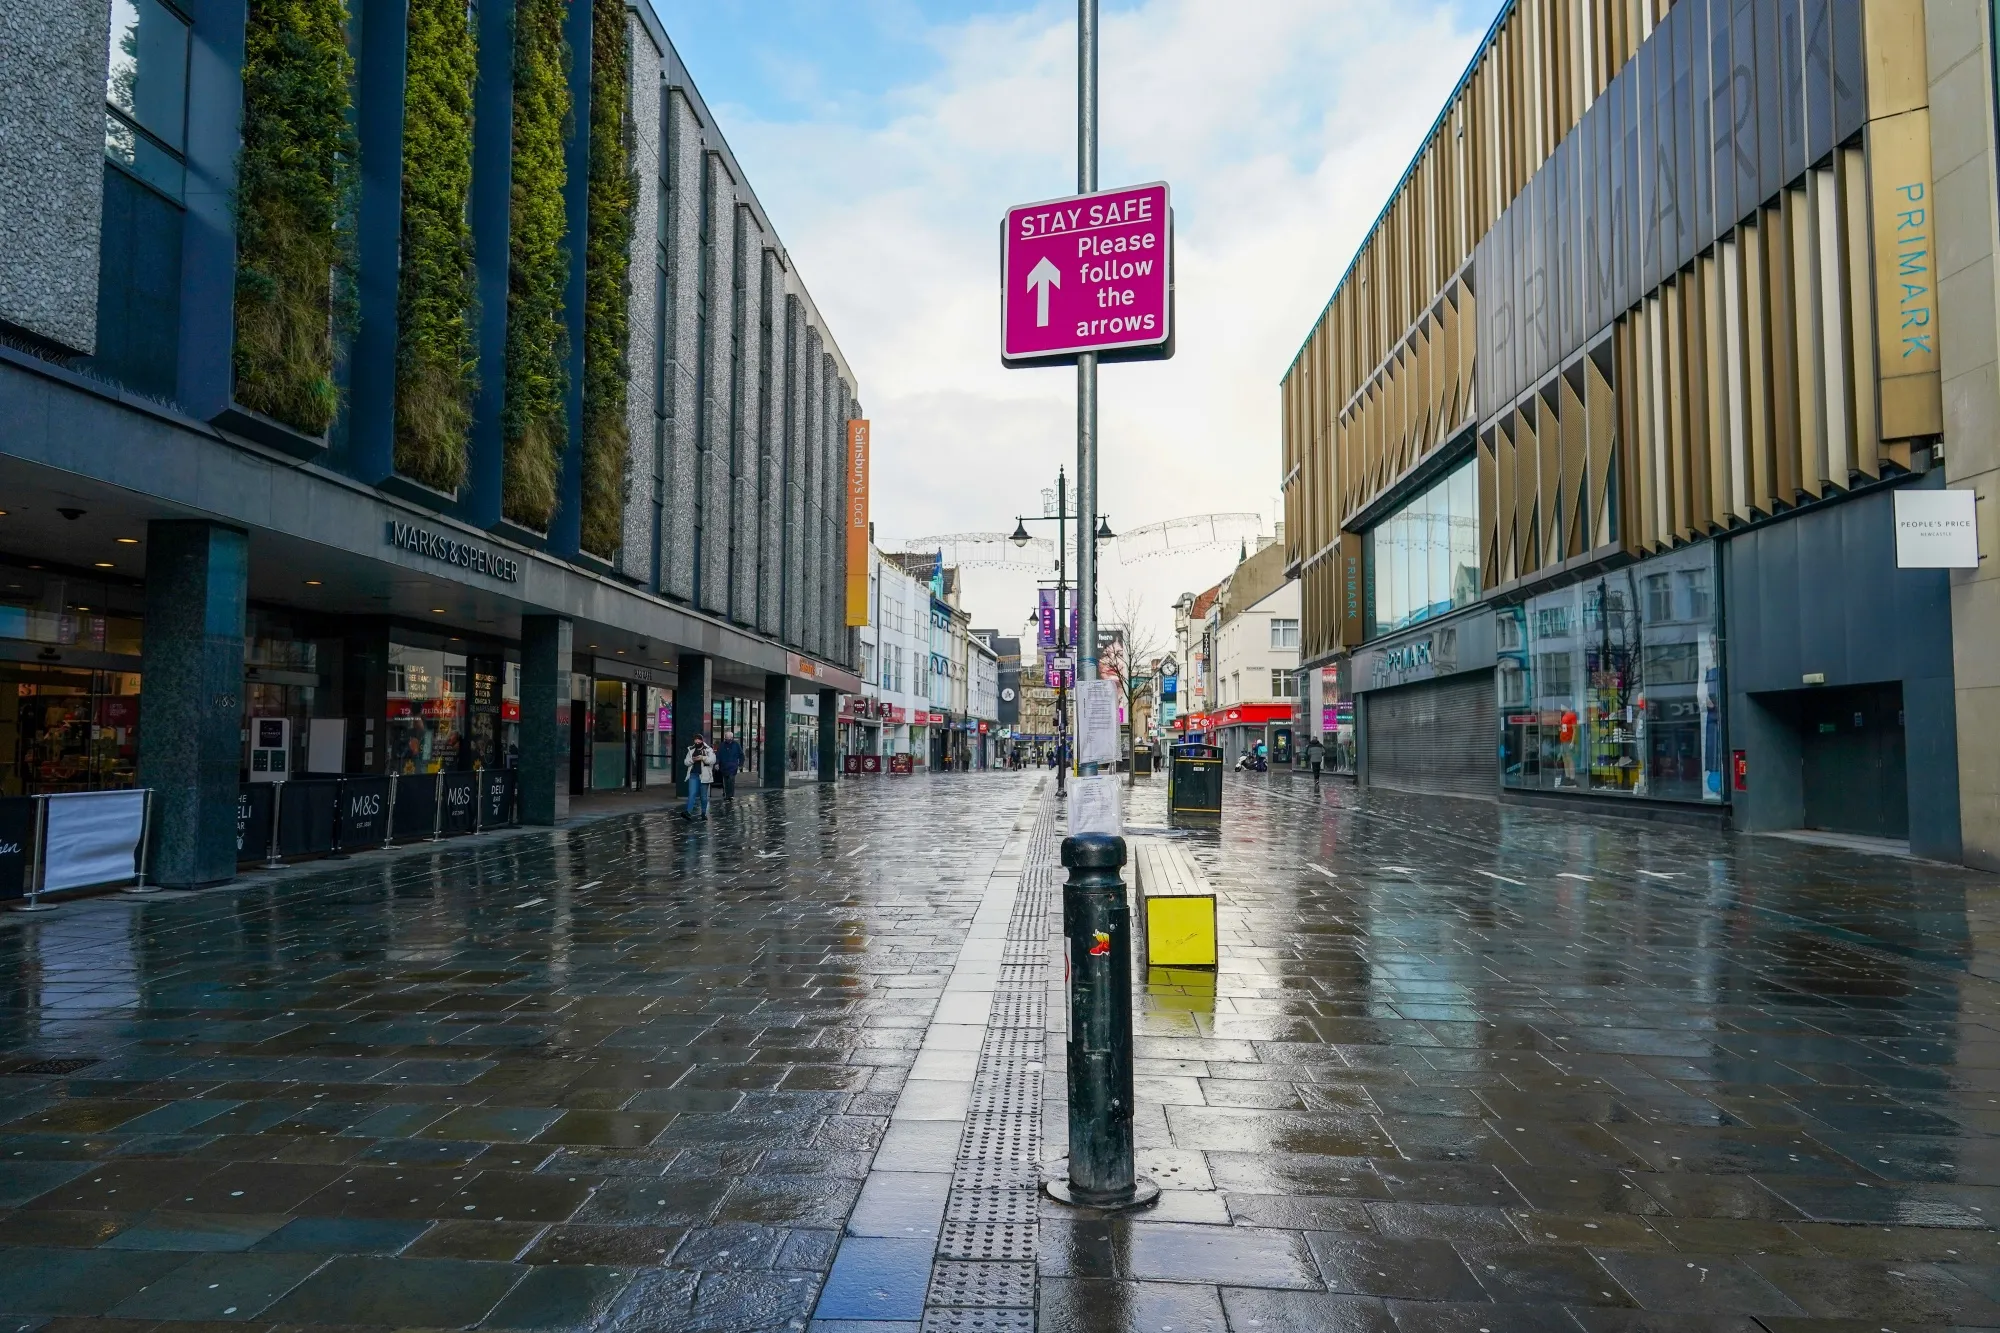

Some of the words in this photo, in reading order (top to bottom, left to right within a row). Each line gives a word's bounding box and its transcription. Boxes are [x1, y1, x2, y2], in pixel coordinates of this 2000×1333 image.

[1021, 208, 1082, 237] STAY
[1089, 197, 1152, 226] SAFE
[1078, 232, 1156, 258] Please
[1080, 259, 1153, 284] follow
[1896, 182, 1932, 358] PRIMARK
[1097, 286, 1135, 308] the
[1076, 313, 1155, 337] arrows
[852, 427, 866, 493] Sainsbury's
[854, 497, 866, 528] Local
[394, 521, 447, 560] MARKS
[449, 540, 459, 564] &
[461, 544, 518, 582] SPENCER
[1348, 557, 1357, 618] PRIMARK
[1386, 641, 1433, 671] PRIMARK
[211, 694, 236, 708] M&S
[238, 794, 247, 803] HE
[449, 786, 470, 805] M&S
[491, 784, 504, 795] DELI
[237, 805, 252, 819] ELI
[351, 794, 380, 817] M&S
[237, 821, 246, 830] AR
